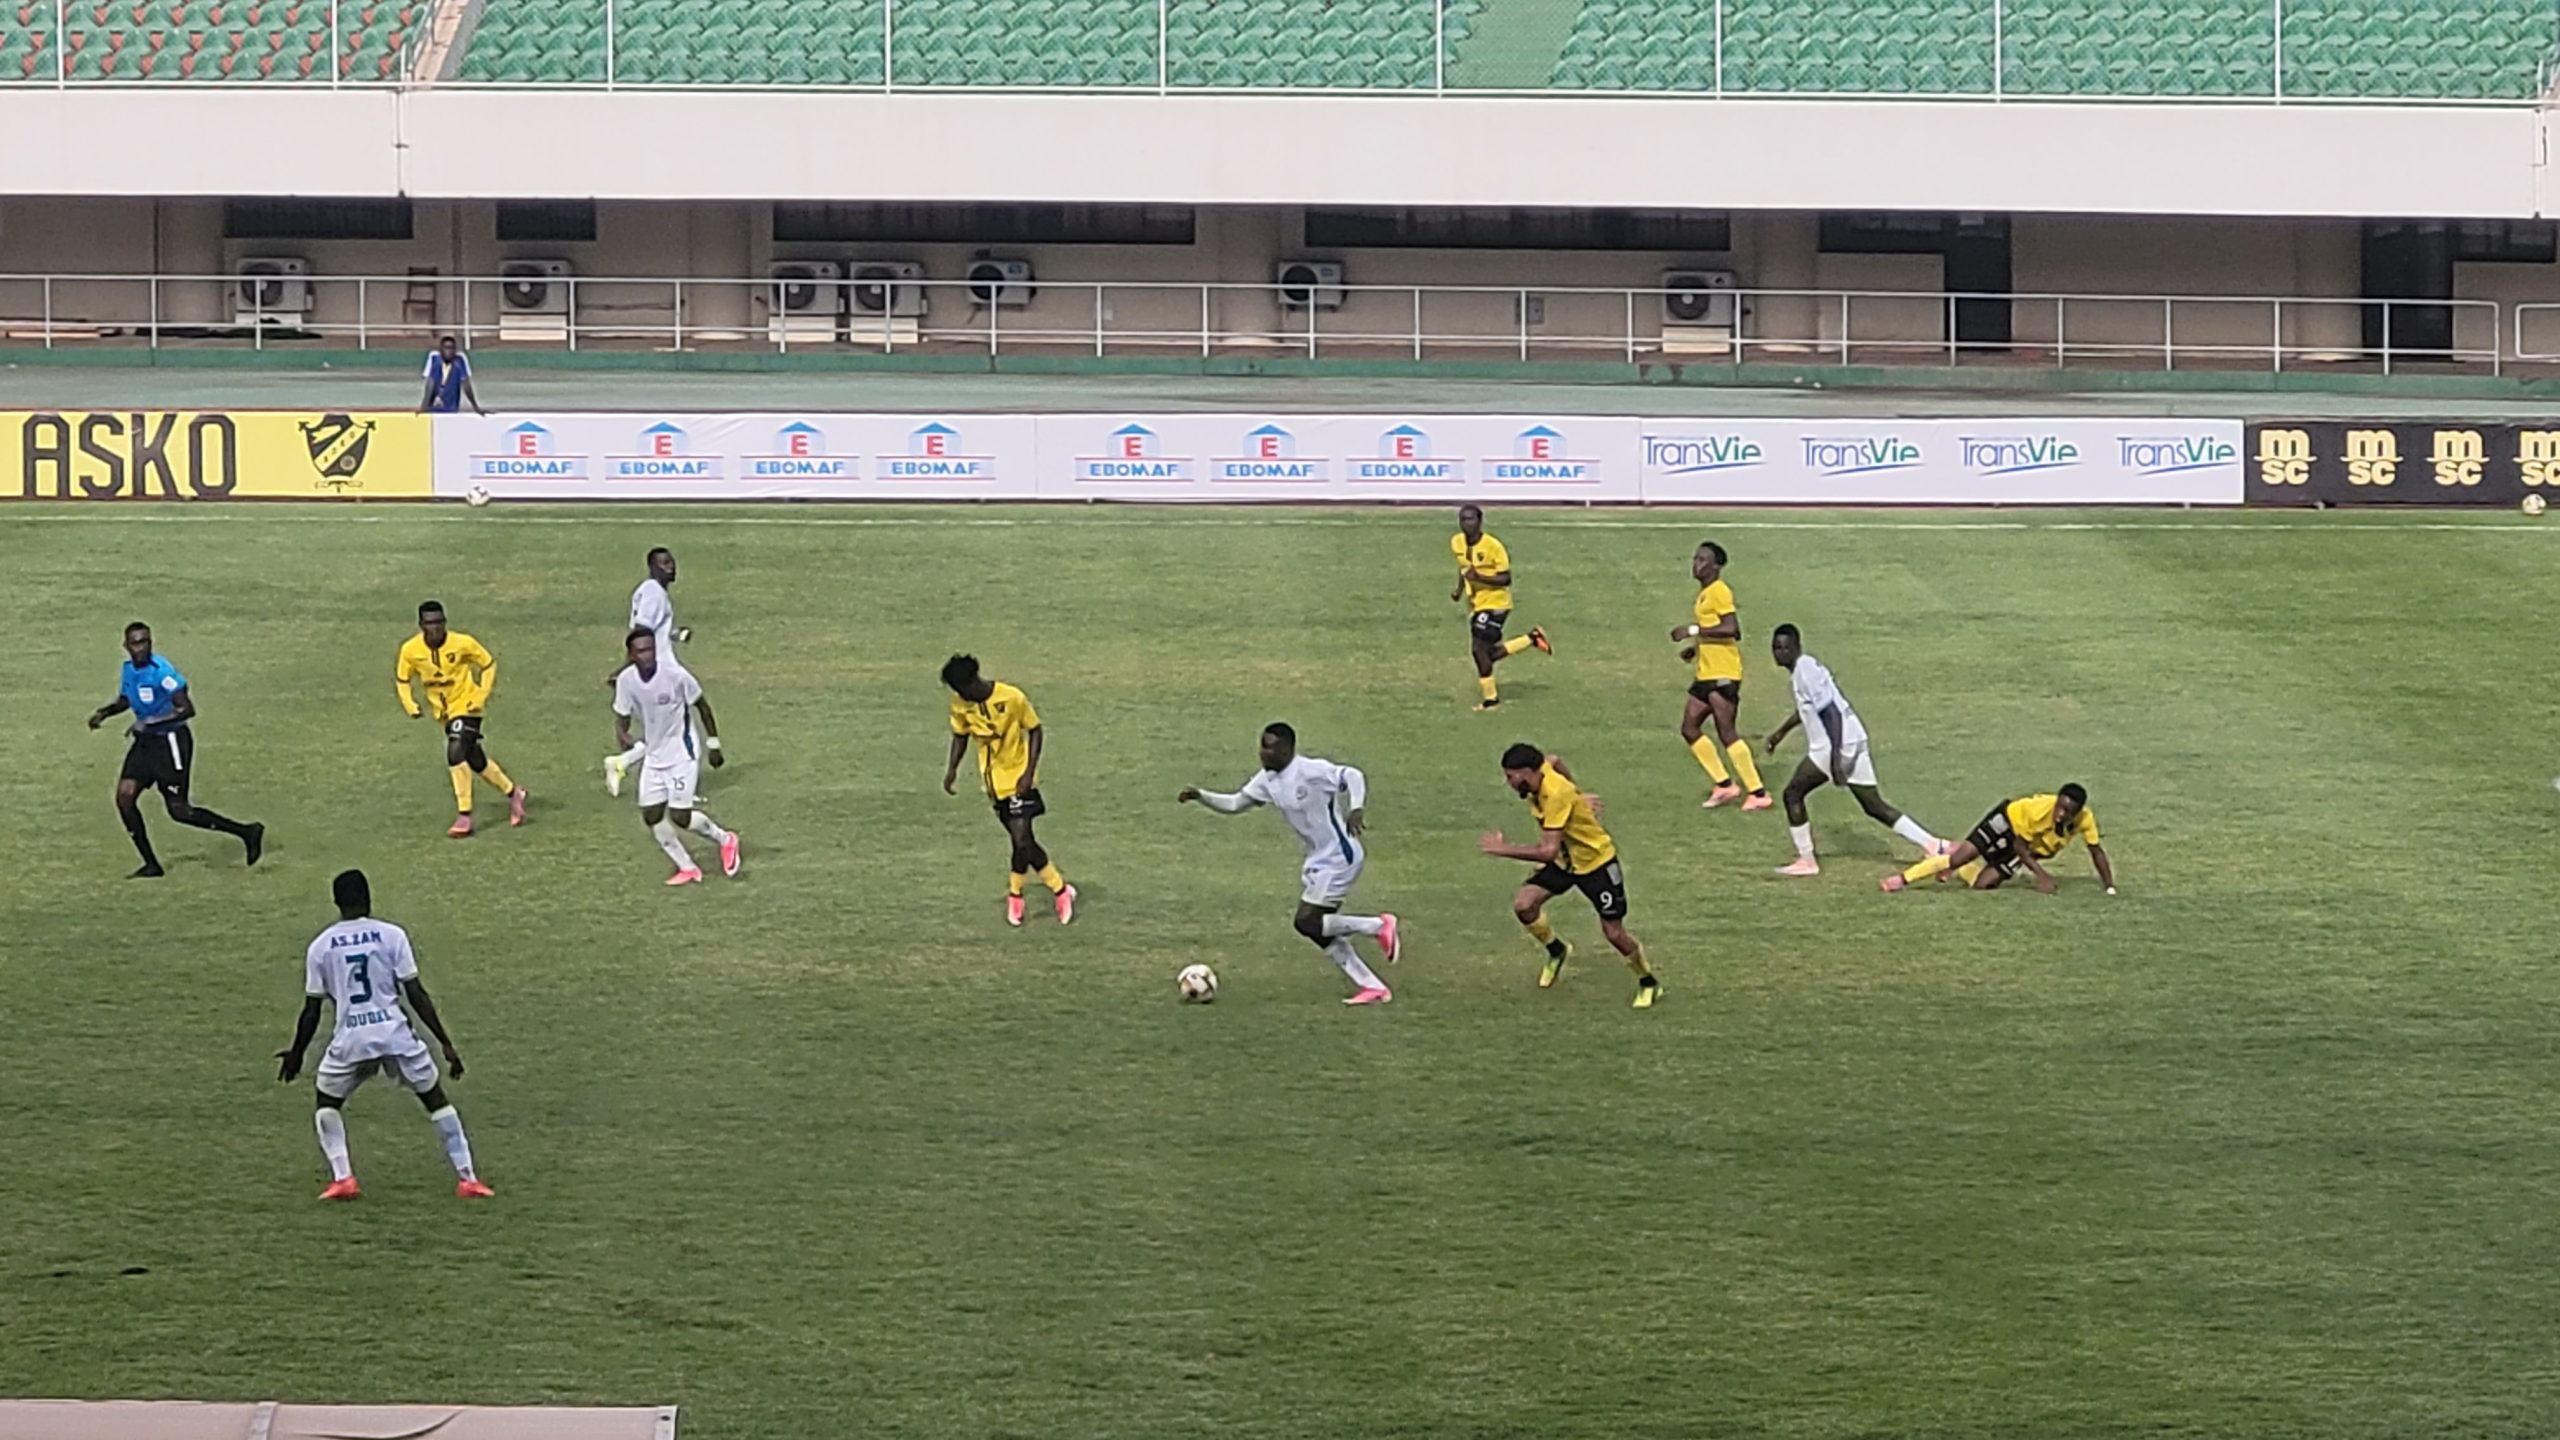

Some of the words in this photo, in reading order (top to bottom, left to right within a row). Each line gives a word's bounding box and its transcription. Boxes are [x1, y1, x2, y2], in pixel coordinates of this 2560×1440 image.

[23, 413, 237, 498] ASKO
[519, 435, 536, 456] E
[655, 435, 672, 456] E
[791, 435, 808, 456] E
[927, 436, 944, 457] E
[1125, 437, 1142, 458] E
[1261, 437, 1278, 458] E
[1396, 437, 1413, 458] E
[1532, 438, 1549, 459] E
[1643, 436, 1762, 466] TransVie
[1800, 437, 1920, 467] TransVie
[1958, 437, 2078, 467] TransVie
[2116, 437, 2236, 467] TransVie
[484, 461, 573, 475] EBOMAF
[620, 461, 708, 475] EBOMAF
[755, 462, 844, 476] EBOMAF
[891, 462, 980, 476] EBOMAF
[1089, 463, 1178, 477] EBOMAF
[1225, 463, 1314, 477] EBOMAF
[1360, 464, 1450, 478] EBOMAF
[1496, 464, 1585, 478] EBOMAF
[1600, 891, 1613, 910] 9
[345, 953, 373, 1004] 3
